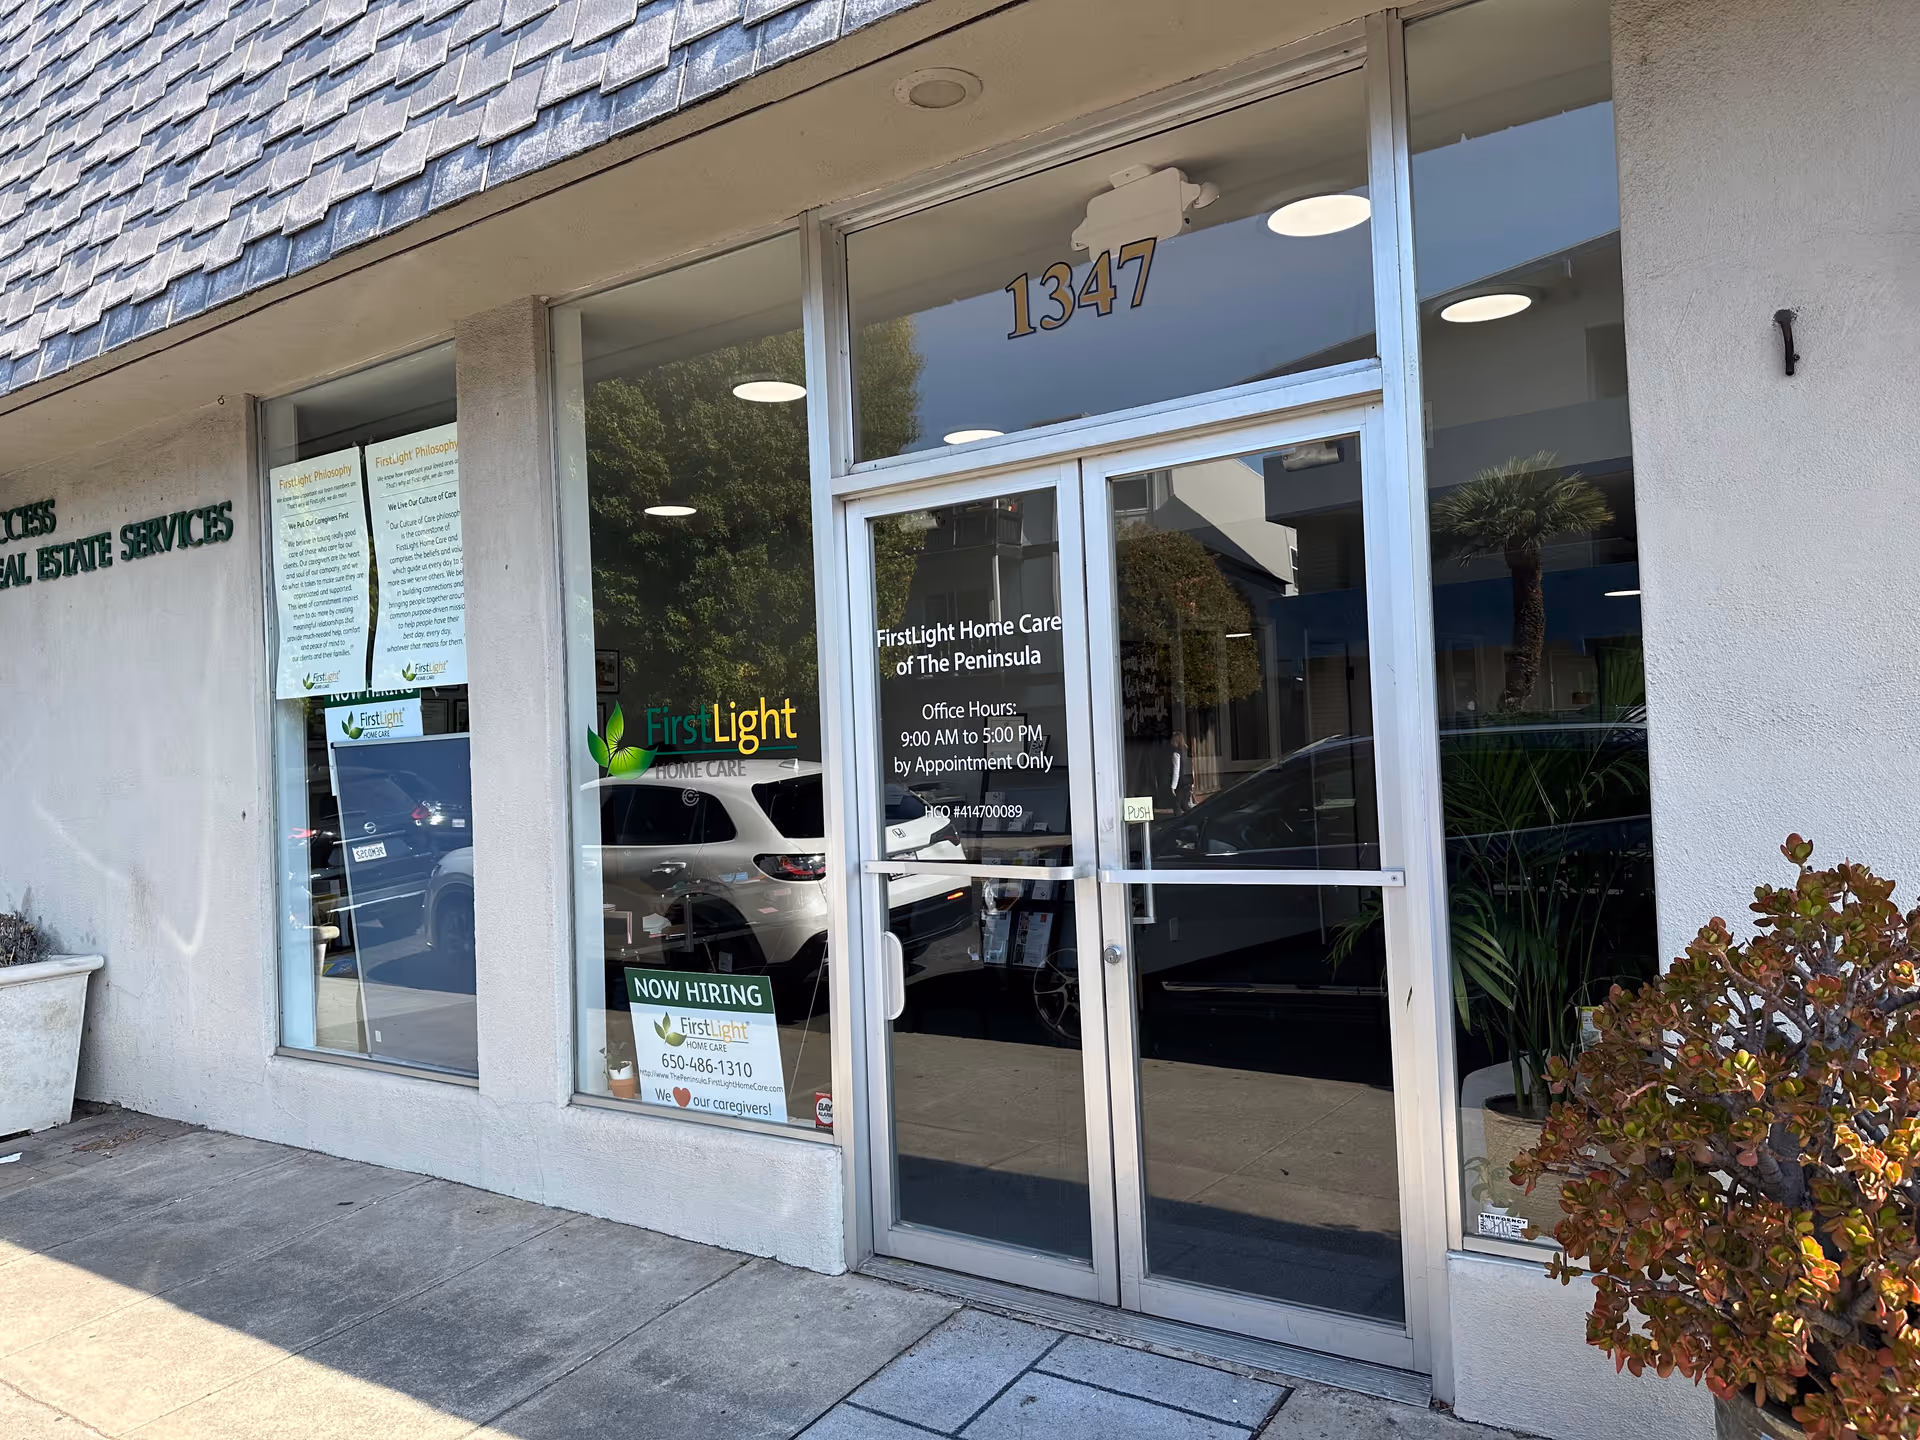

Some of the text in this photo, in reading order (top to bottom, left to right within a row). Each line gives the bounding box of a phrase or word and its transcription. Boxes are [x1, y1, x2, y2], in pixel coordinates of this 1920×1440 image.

[1004, 235, 1158, 340] 1347
[376, 439, 458, 468] FirstLight Philosophy
[280, 464, 351, 489] FirstLight Philosophy
[419, 496, 437, 505] Culture
[438, 492, 444, 500] of
[445, 491, 456, 499] Care
[400, 519, 417, 528] Culture
[418, 516, 423, 524] of
[437, 510, 460, 522] philosoph
[445, 522, 450, 531] of
[36, 531, 113, 581] ESTATE
[119, 500, 234, 562] SERVICES
[344, 529, 356, 538] good
[448, 534, 458, 542] and
[414, 552, 422, 560] the
[424, 549, 440, 558] beliefs
[441, 547, 451, 555] and
[428, 561, 442, 569] every
[443, 559, 452, 567] day
[402, 586, 422, 596] building
[422, 582, 452, 592] connections
[389, 600, 408, 609] bringing
[427, 595, 448, 604] together
[412, 607, 448, 617] purpose-driven
[416, 619, 433, 627] people
[877, 613, 1062, 648] FirstLight Home Care
[415, 660, 446, 674] FirstLight
[896, 645, 1041, 676] of The Peninsula
[922, 700, 1017, 720] Office Hours:
[360, 708, 403, 729] FirstLight
[646, 696, 798, 755] FirstLight
[364, 730, 390, 739] HOME CARE
[900, 724, 1043, 747] 9:00 AM to 5:00 PM
[655, 759, 747, 780] HOME CARE
[894, 757, 912, 777] by
[915, 753, 1013, 776] Appointment
[1016, 751, 1053, 773] Only
[925, 804, 1023, 818] HCO #414700089
[1128, 805, 1151, 820] PUSH
[633, 976, 763, 1007] NOW HIRING
[680, 1017, 749, 1043] FirstLight
[686, 1040, 727, 1053] HOME CARE
[661, 1053, 753, 1078] 650-486-1310
[655, 1088, 772, 1117] We our caregivers!
[818, 1103, 833, 1112] BAY
[1480, 1214, 1526, 1224] EMERGENCY
